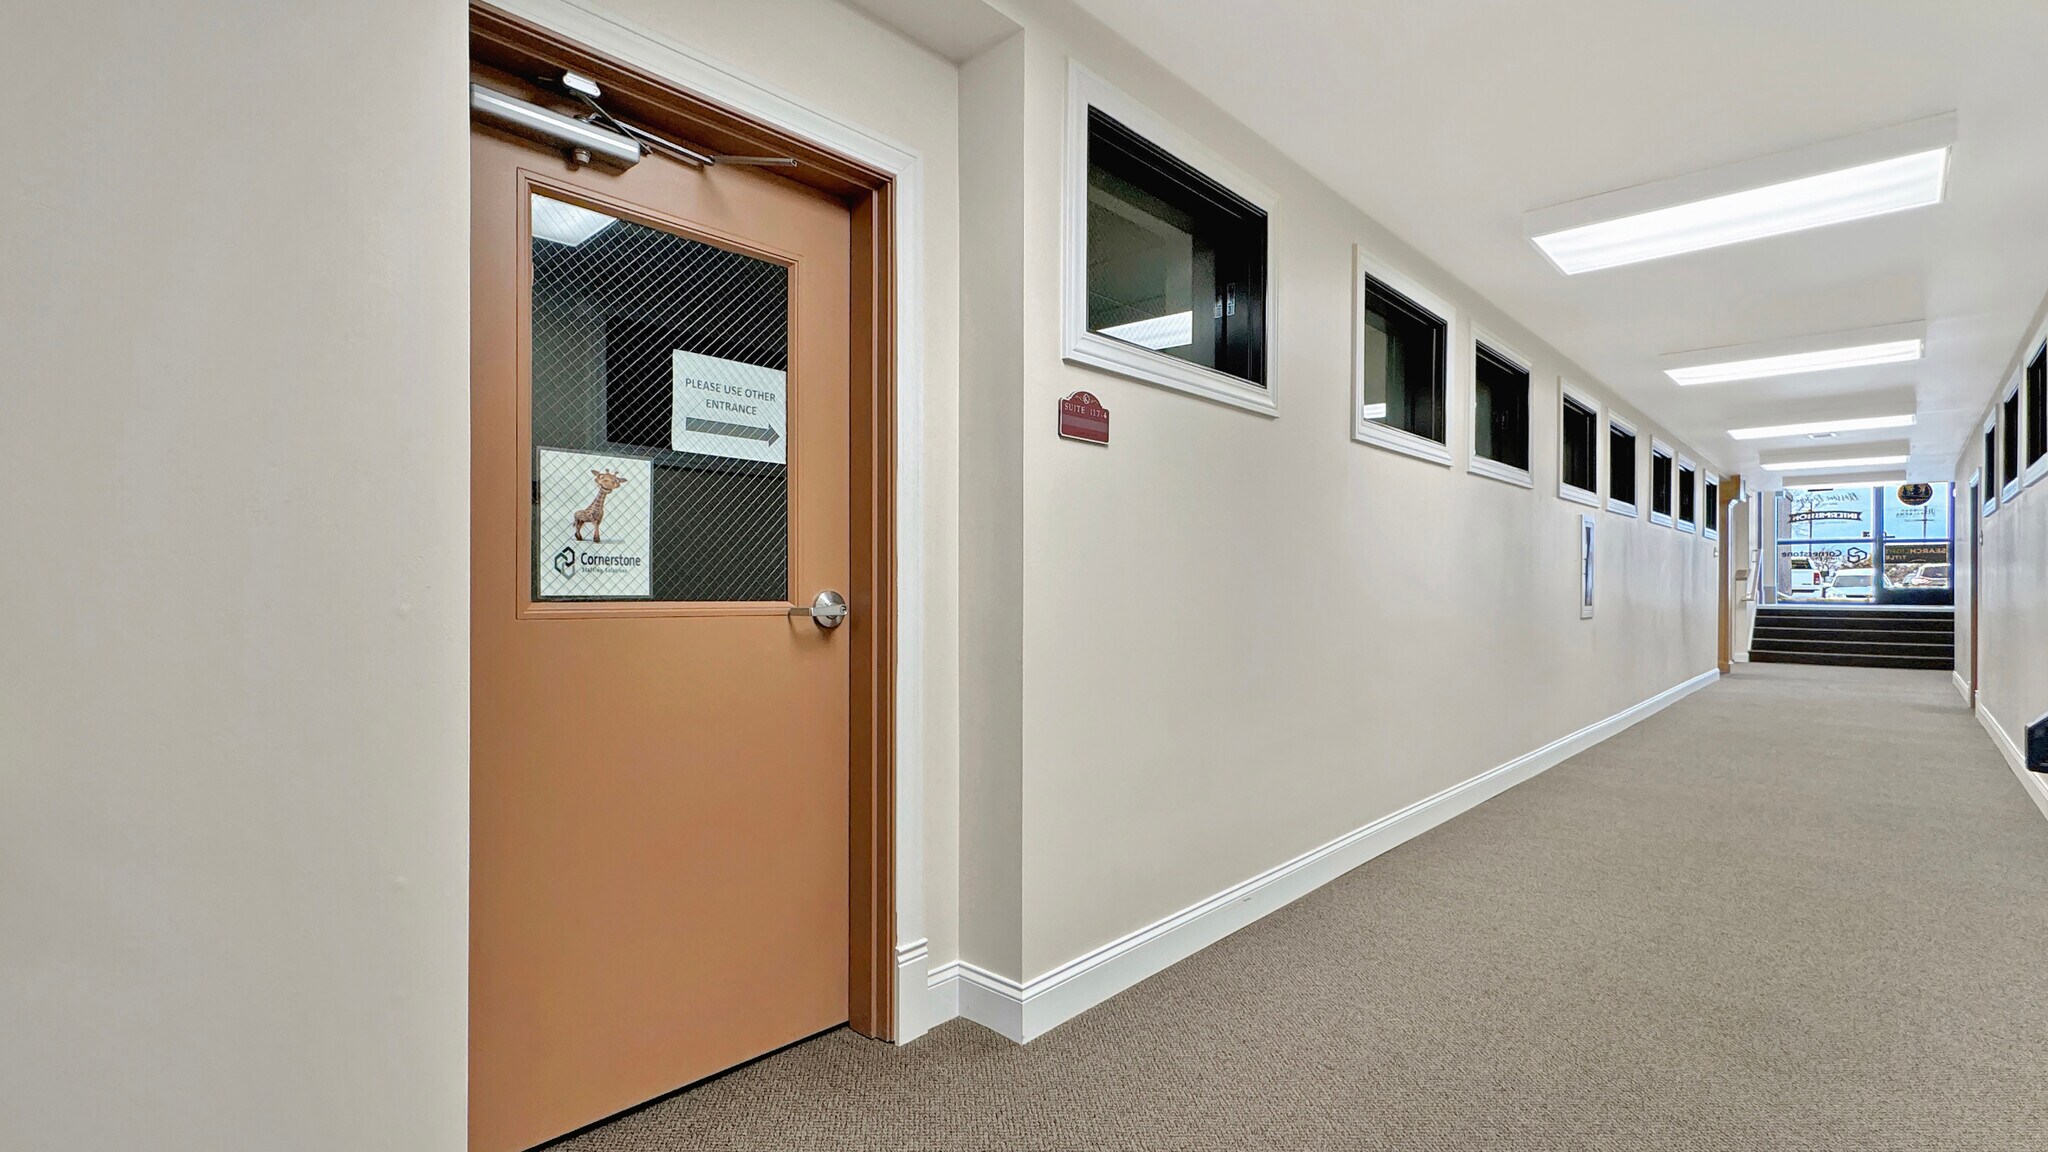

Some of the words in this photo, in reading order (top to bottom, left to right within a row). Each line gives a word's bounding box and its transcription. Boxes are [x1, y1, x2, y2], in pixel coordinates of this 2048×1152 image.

[685, 378, 721, 393] PLEASE
[724, 384, 742, 396] USE
[745, 388, 776, 402] OTHER
[706, 399, 757, 416] ENTRANCE
[1064, 402, 1085, 414] SUITE
[581, 552, 641, 567] Cornerstone
